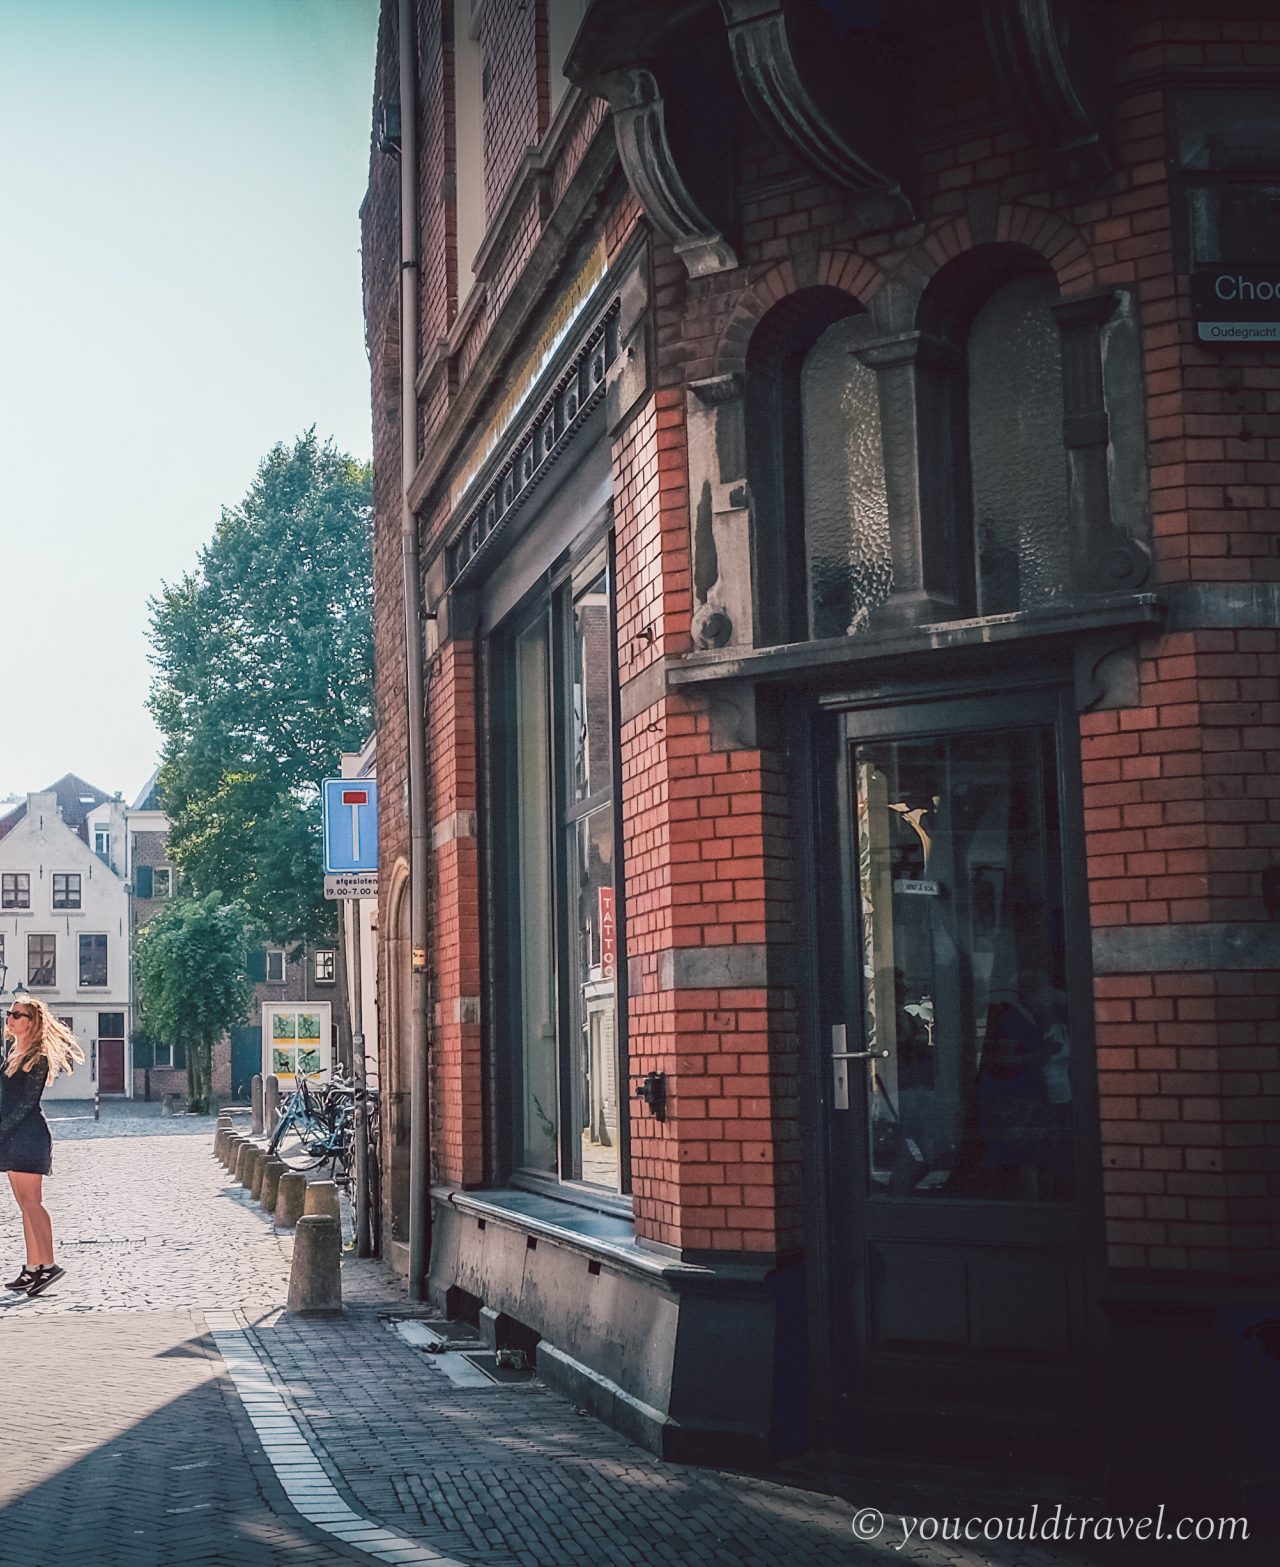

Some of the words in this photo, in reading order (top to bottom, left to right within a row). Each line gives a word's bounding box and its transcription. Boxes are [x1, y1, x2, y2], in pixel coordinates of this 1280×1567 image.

[1215, 275, 1280, 300] Cho
[1211, 326, 1277, 339] Oudegracht
[336, 877, 378, 887] afgesloten
